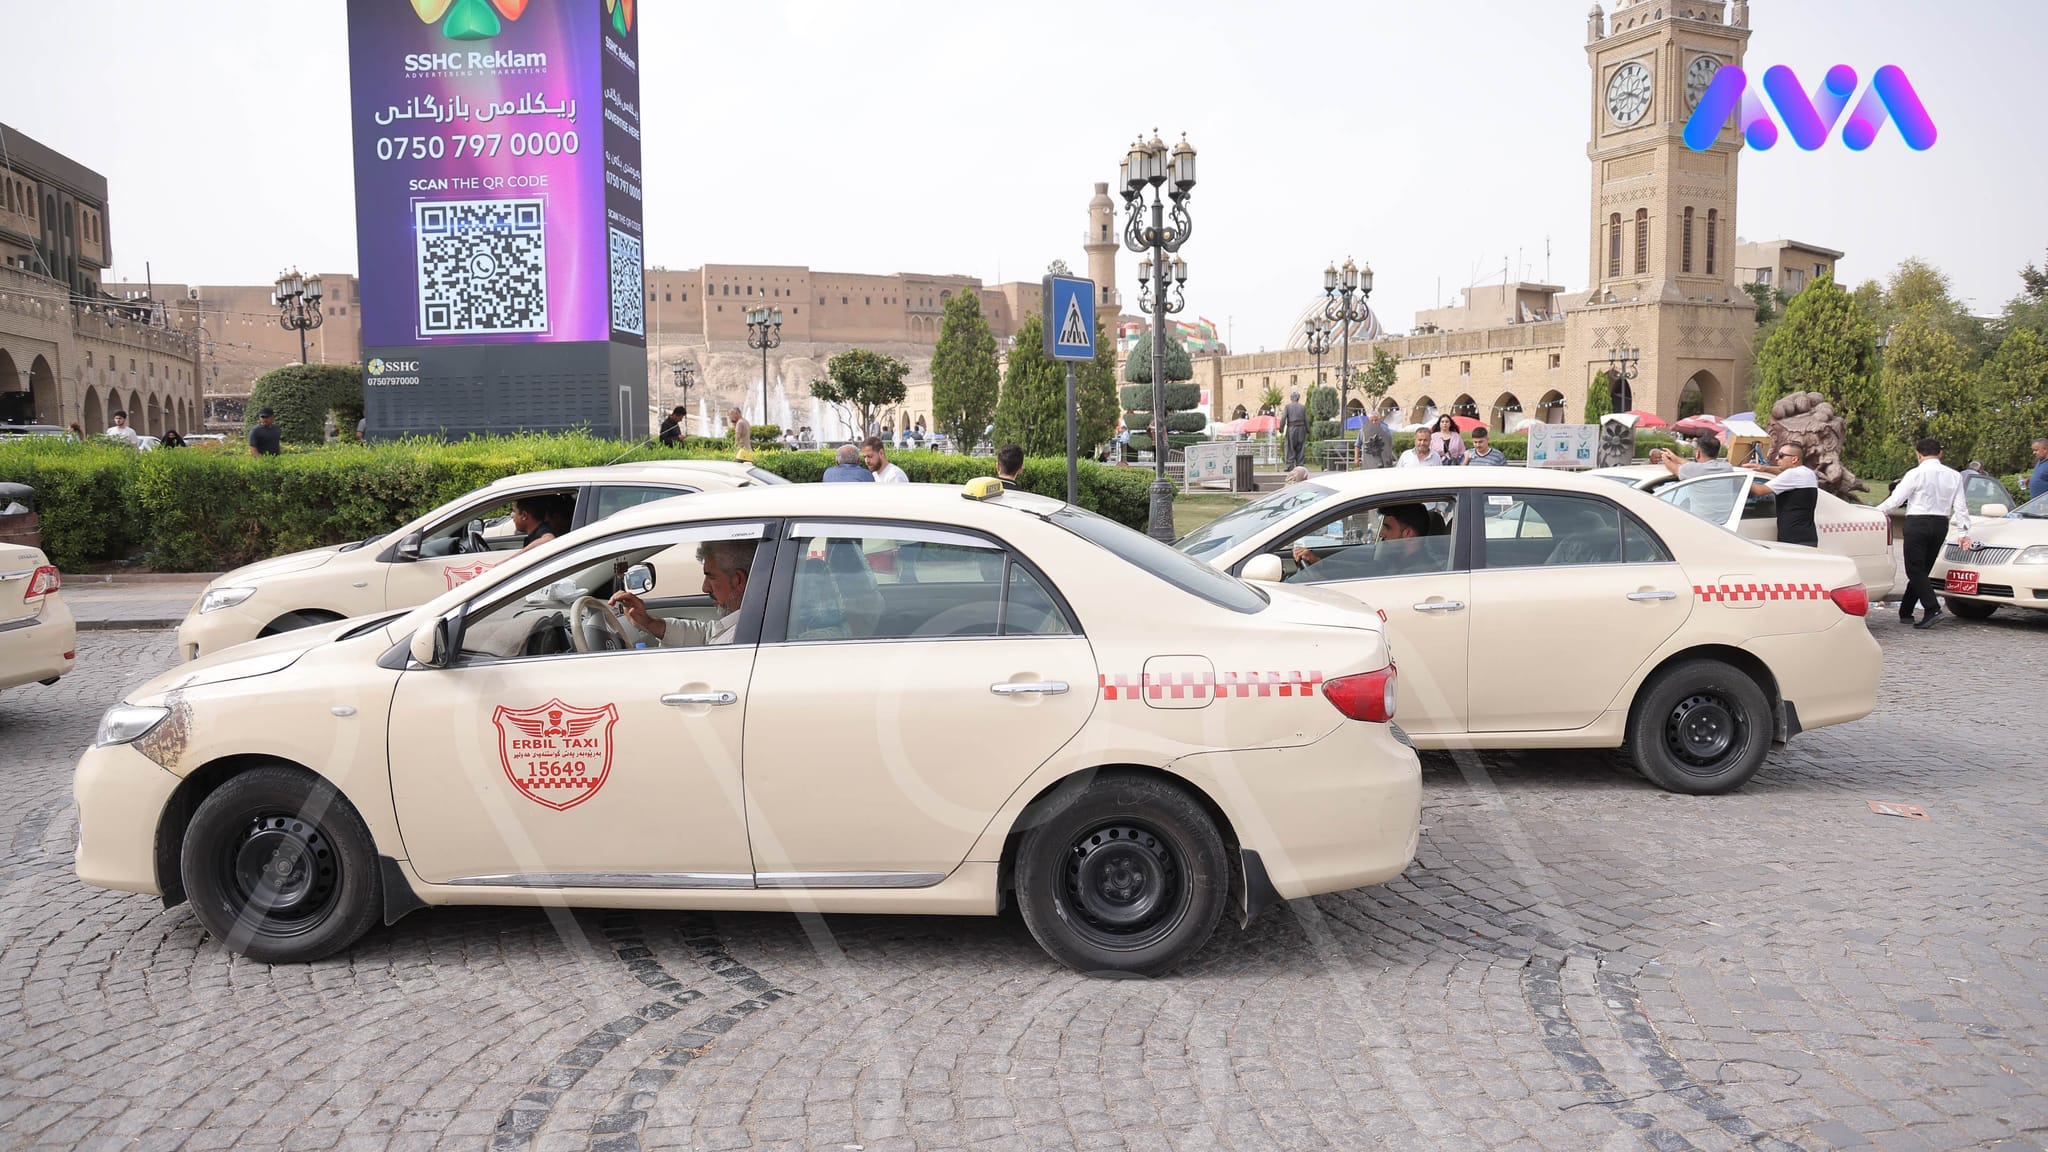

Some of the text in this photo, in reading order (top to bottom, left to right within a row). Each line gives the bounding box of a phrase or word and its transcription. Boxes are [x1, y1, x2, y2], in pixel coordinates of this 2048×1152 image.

[405, 50, 547, 71] SSHC Reklam
[405, 70, 473, 78] ADVERTISING
[377, 131, 579, 160] 0750 797 0000
[409, 174, 548, 191] SCAN THE QR CODE
[385, 361, 420, 371] SSHC
[367, 377, 420, 386] 07507970000
[512, 738, 598, 749] ERBIL TAXI
[528, 761, 586, 777] 15649
